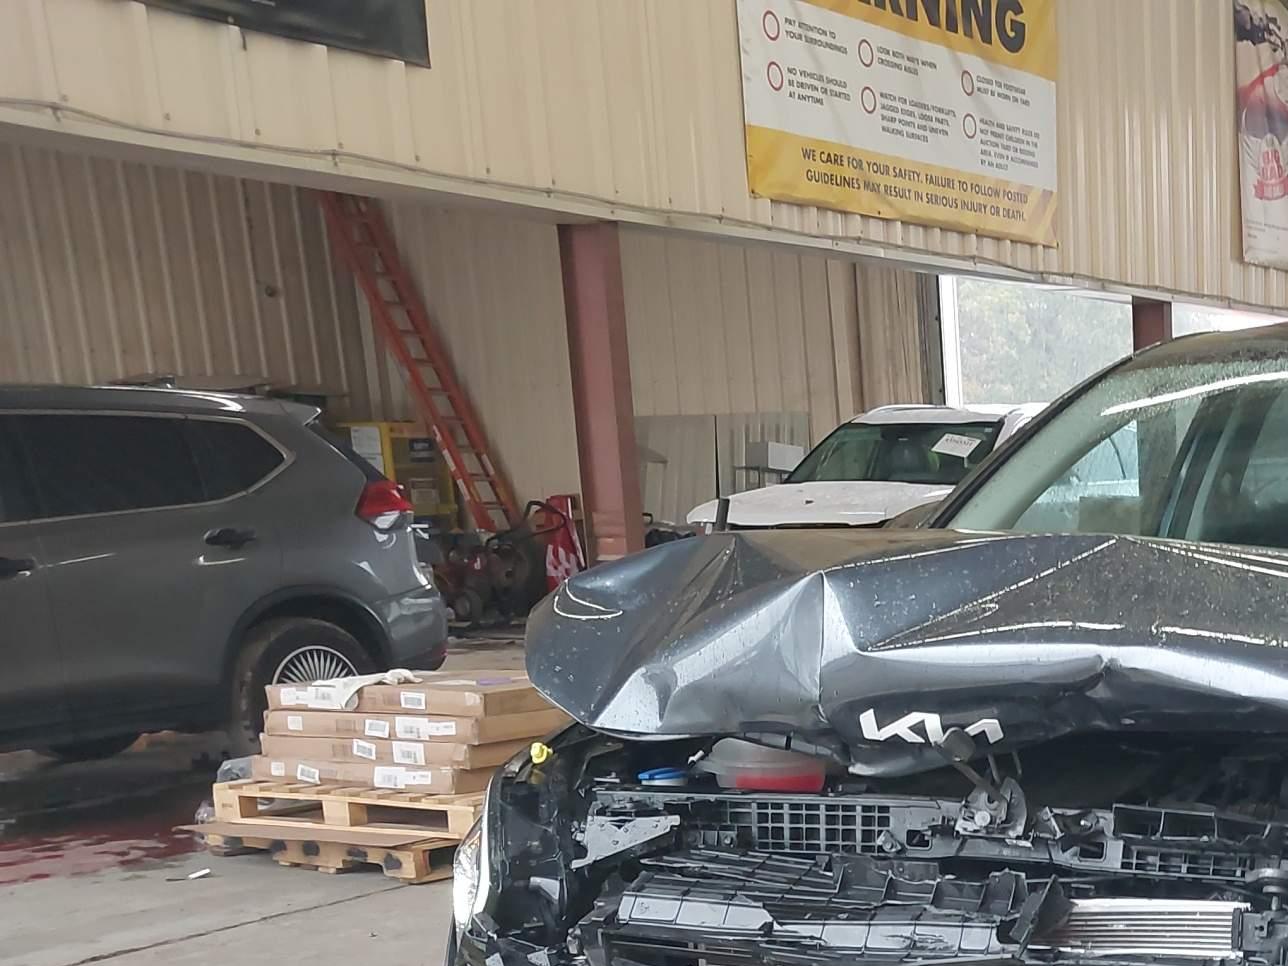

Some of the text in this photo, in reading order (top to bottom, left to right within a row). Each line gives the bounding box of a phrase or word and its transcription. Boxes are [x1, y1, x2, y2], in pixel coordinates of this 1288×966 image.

[785, 30, 803, 41] YOUR
[829, 31, 836, 39] TO
[920, 59, 937, 70] WHEN
[787, 67, 848, 89] NO VEHICLES SHOULD
[796, 81, 819, 92] DRIVEN
[820, 86, 828, 95] OR
[789, 91, 824, 106] AT ANYTIME
[801, 147, 1028, 204] WE CARE FOR YOUR SAFETY. FAILURE TO FOLLOW POSTED
[806, 169, 860, 190] GUIDELINES
[863, 180, 881, 193] MAY
[884, 184, 912, 201] RESULT
[914, 190, 923, 203] IN
[925, 192, 958, 209] SERIOUS
[960, 199, 986, 215] INJURY
[989, 205, 1000, 217] OR
